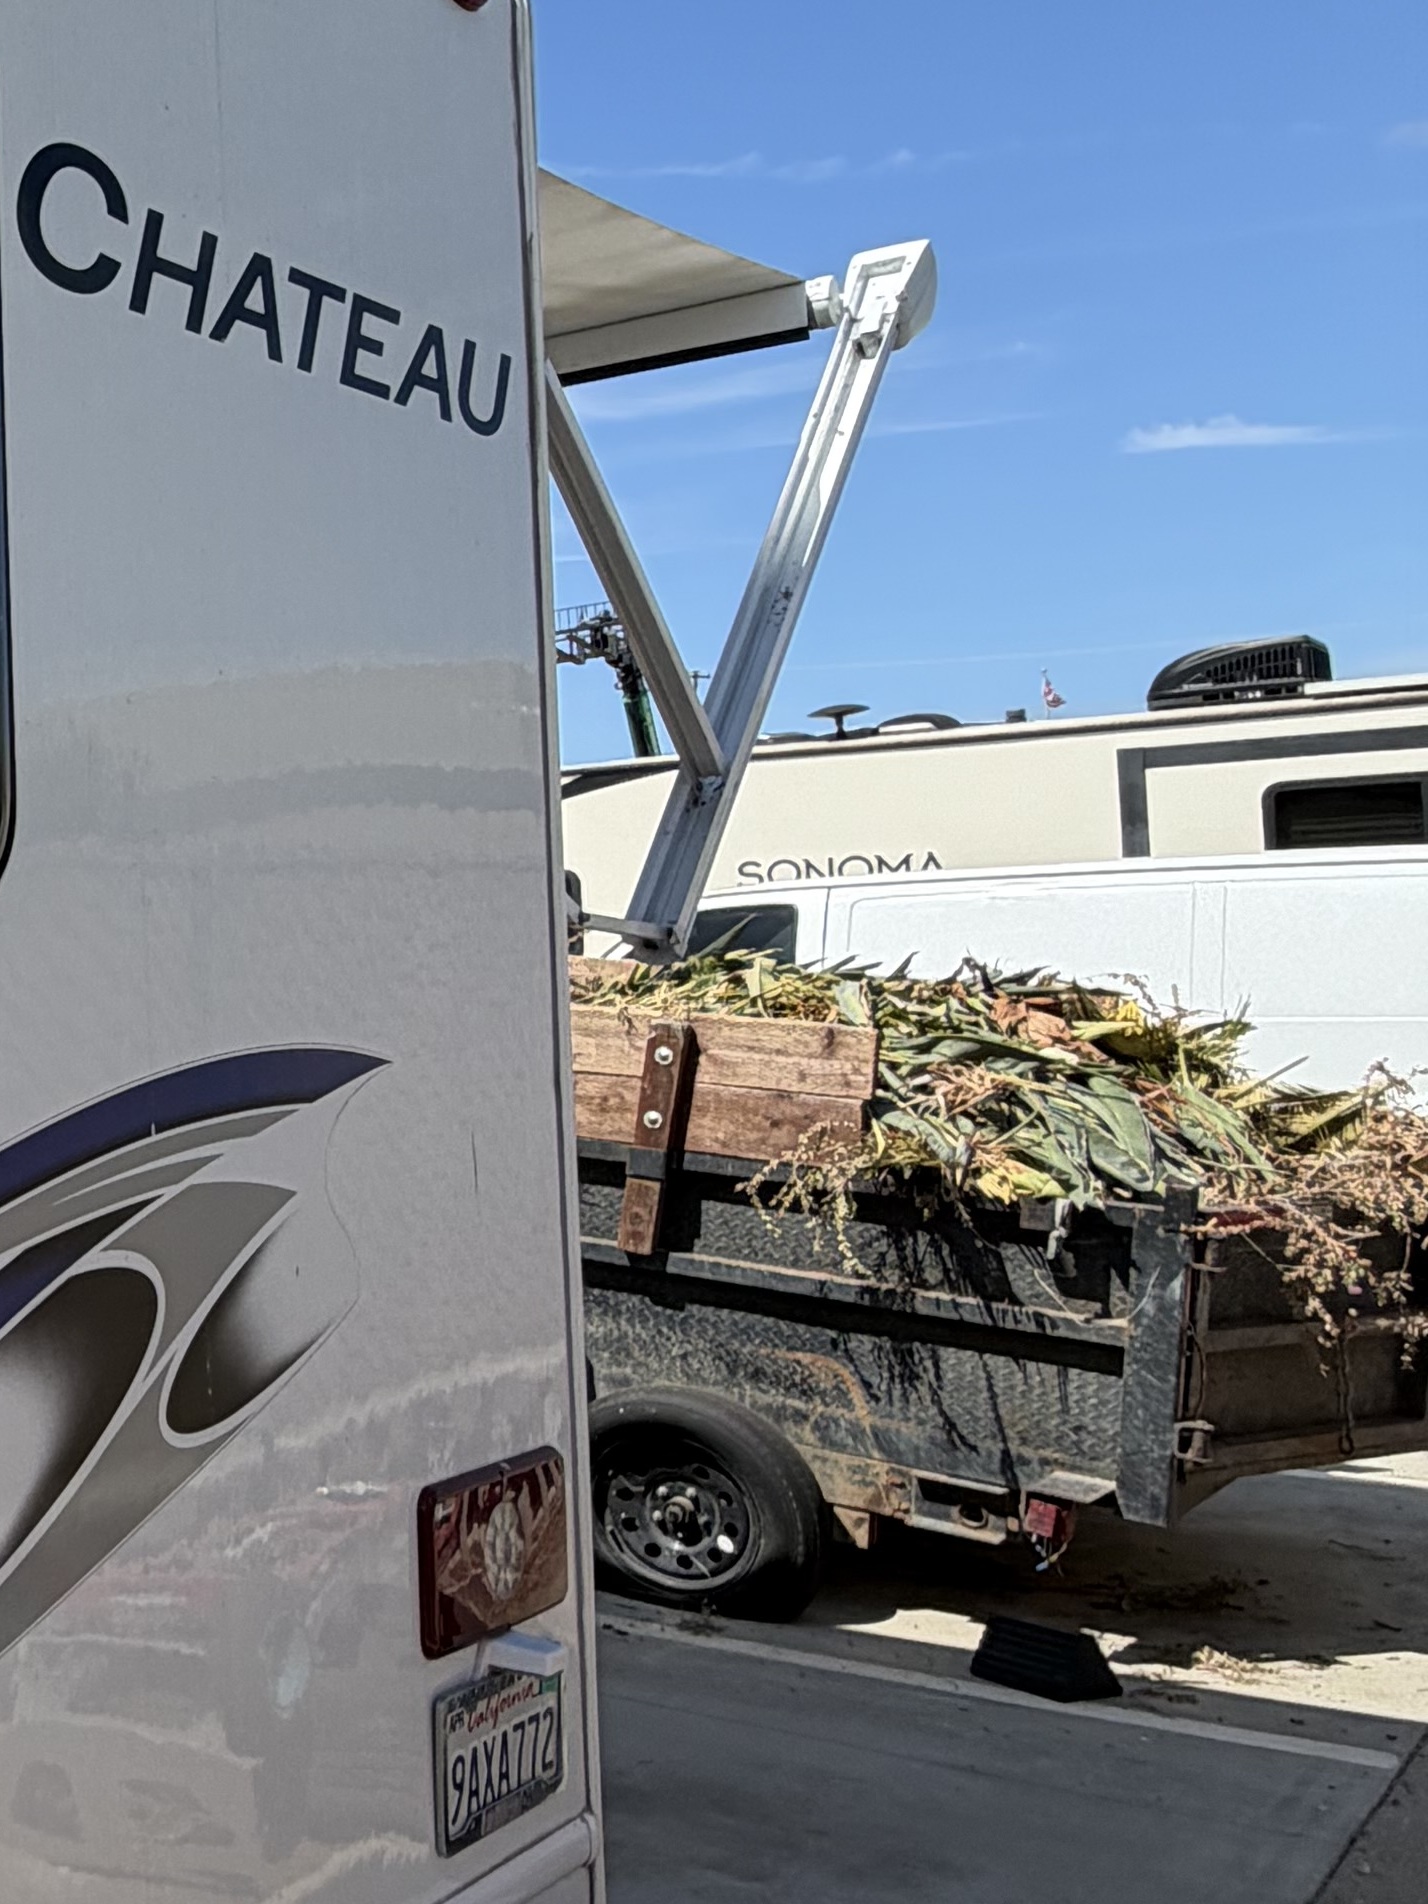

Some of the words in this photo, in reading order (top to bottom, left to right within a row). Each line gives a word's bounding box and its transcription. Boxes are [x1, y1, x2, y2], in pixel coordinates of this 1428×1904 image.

[16, 142, 512, 437] CHATEAU
[737, 851, 943, 887] SONOMA
[467, 1681, 538, 1733] California
[451, 1706, 555, 1827] 9AXA772
